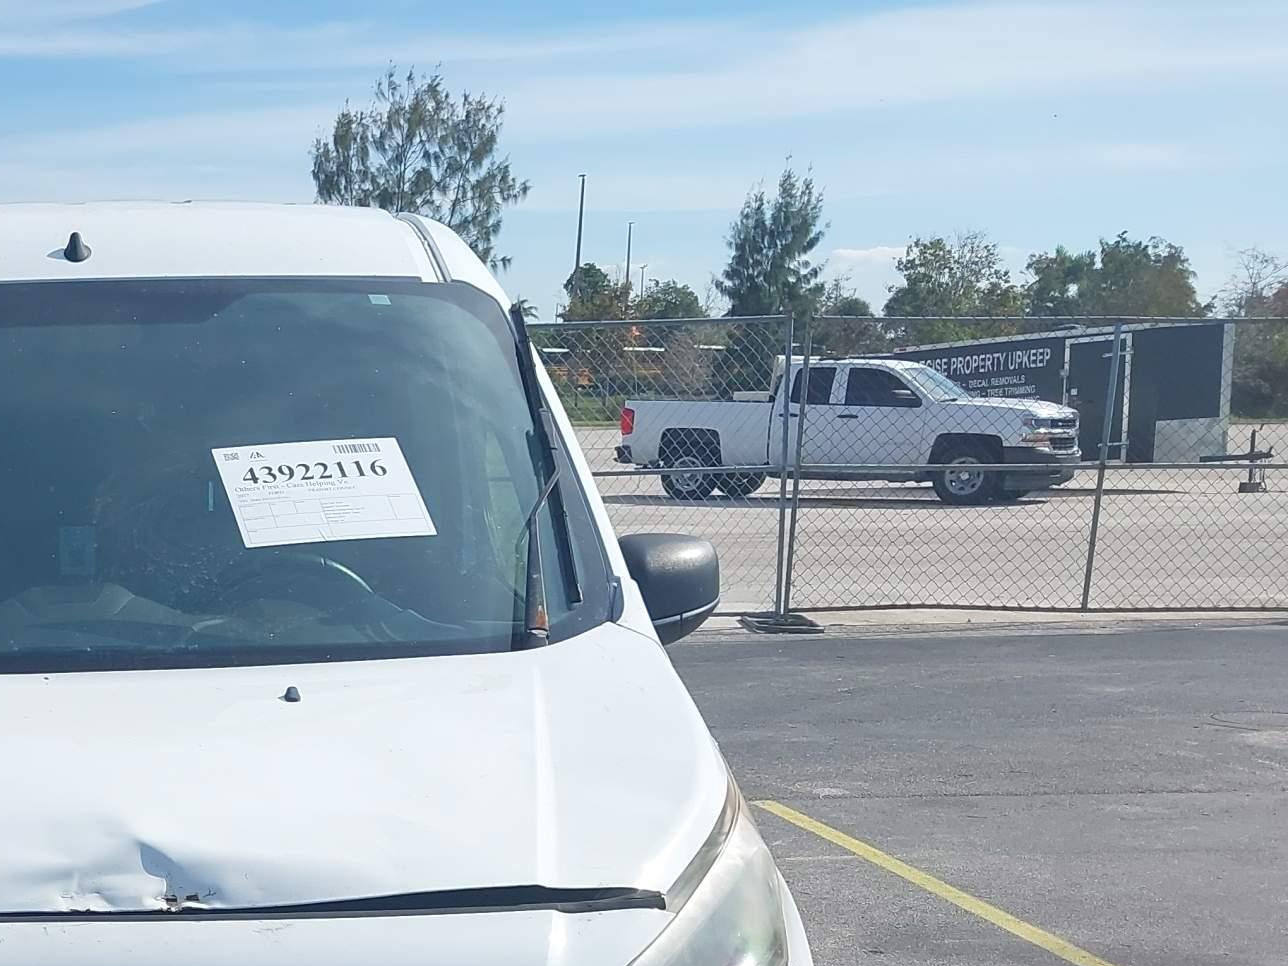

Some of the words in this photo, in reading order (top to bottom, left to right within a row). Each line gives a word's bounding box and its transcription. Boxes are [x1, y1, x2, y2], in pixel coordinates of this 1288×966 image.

[951, 352, 1006, 375] PROPERTY
[1008, 348, 1051, 370] UPKEEP
[969, 379, 989, 388] DECAL
[991, 375, 1025, 386] REMOVALS
[987, 388, 1004, 397] TREE
[1005, 385, 1036, 396] TRIMMING
[242, 458, 388, 485] 43922116
